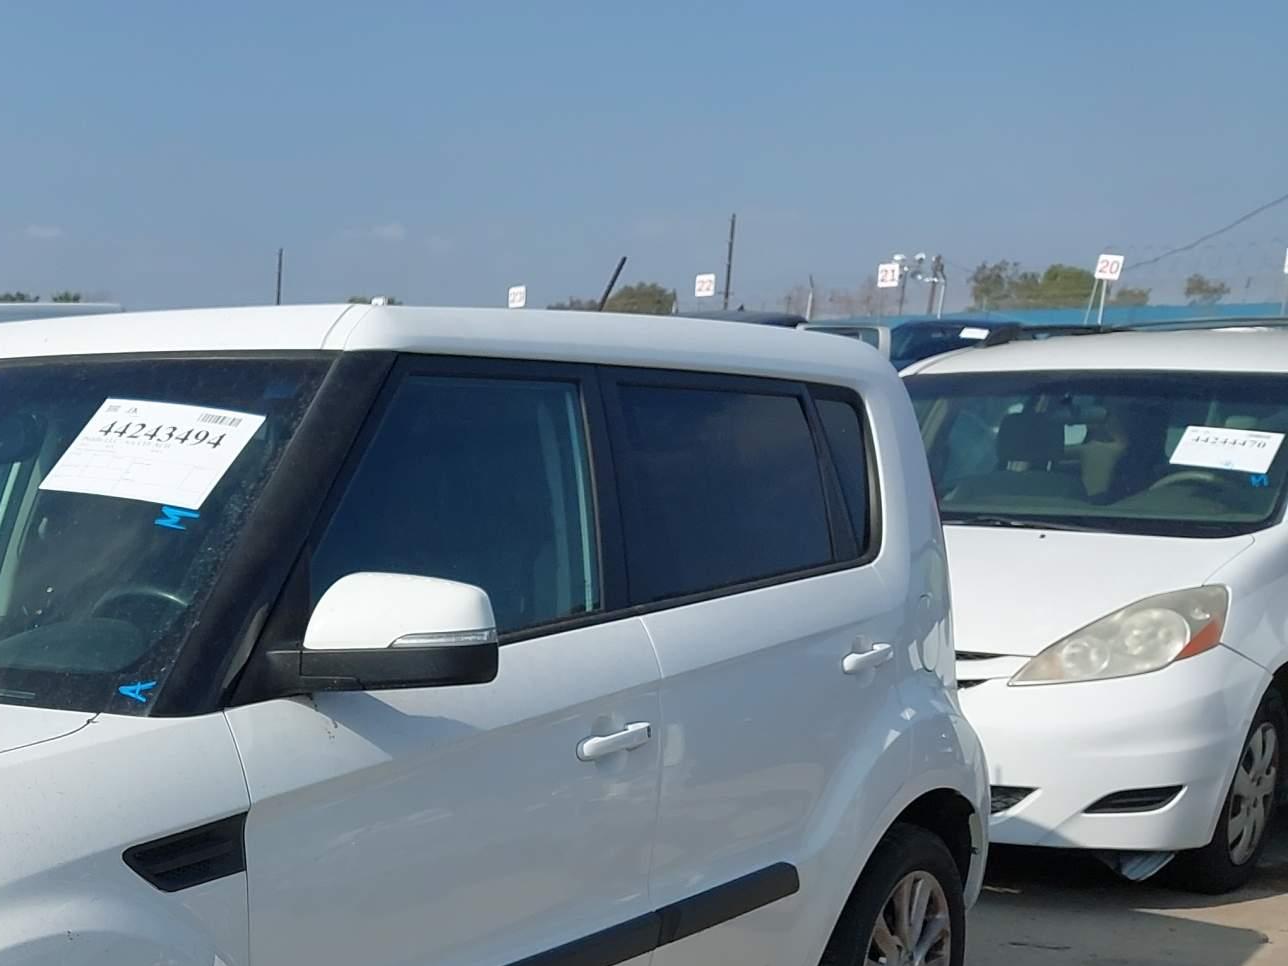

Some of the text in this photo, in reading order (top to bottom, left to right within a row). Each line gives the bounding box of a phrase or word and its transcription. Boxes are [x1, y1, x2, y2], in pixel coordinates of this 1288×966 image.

[1098, 260, 1120, 275] 20
[880, 269, 897, 282] 21
[696, 278, 713, 292] 22
[98, 421, 227, 449] 44243494
[119, 680, 157, 703] A
